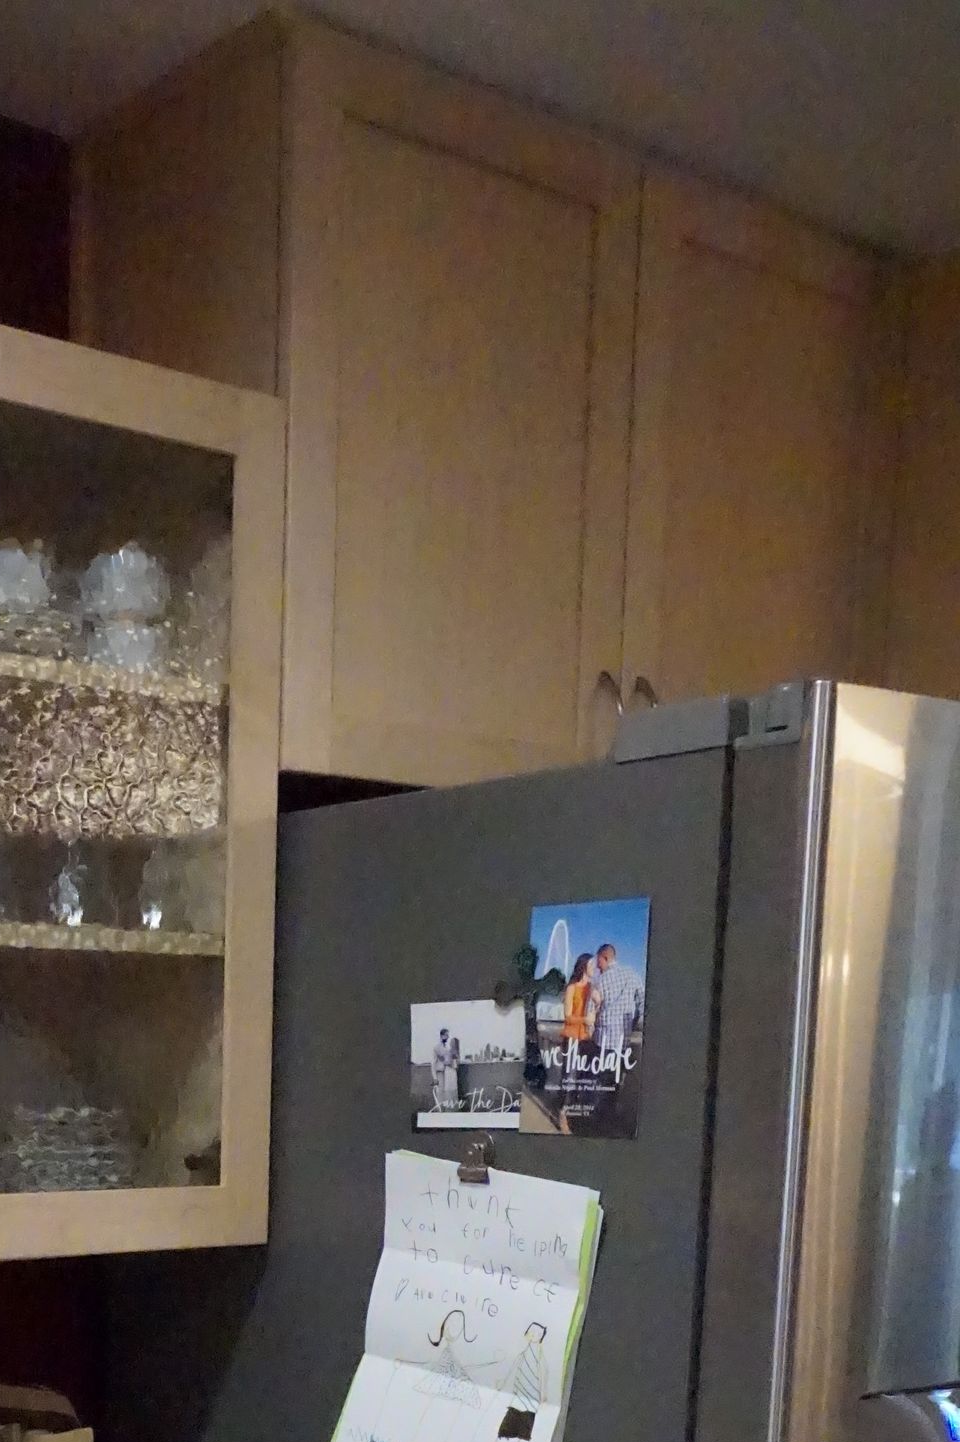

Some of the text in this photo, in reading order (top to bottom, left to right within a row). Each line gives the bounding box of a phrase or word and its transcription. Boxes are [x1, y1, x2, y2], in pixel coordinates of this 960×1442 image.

[561, 1037, 590, 1073] the
[591, 1032, 637, 1083] date
[428, 1085, 466, 1113] Save
[409, 1240, 439, 1263] to
